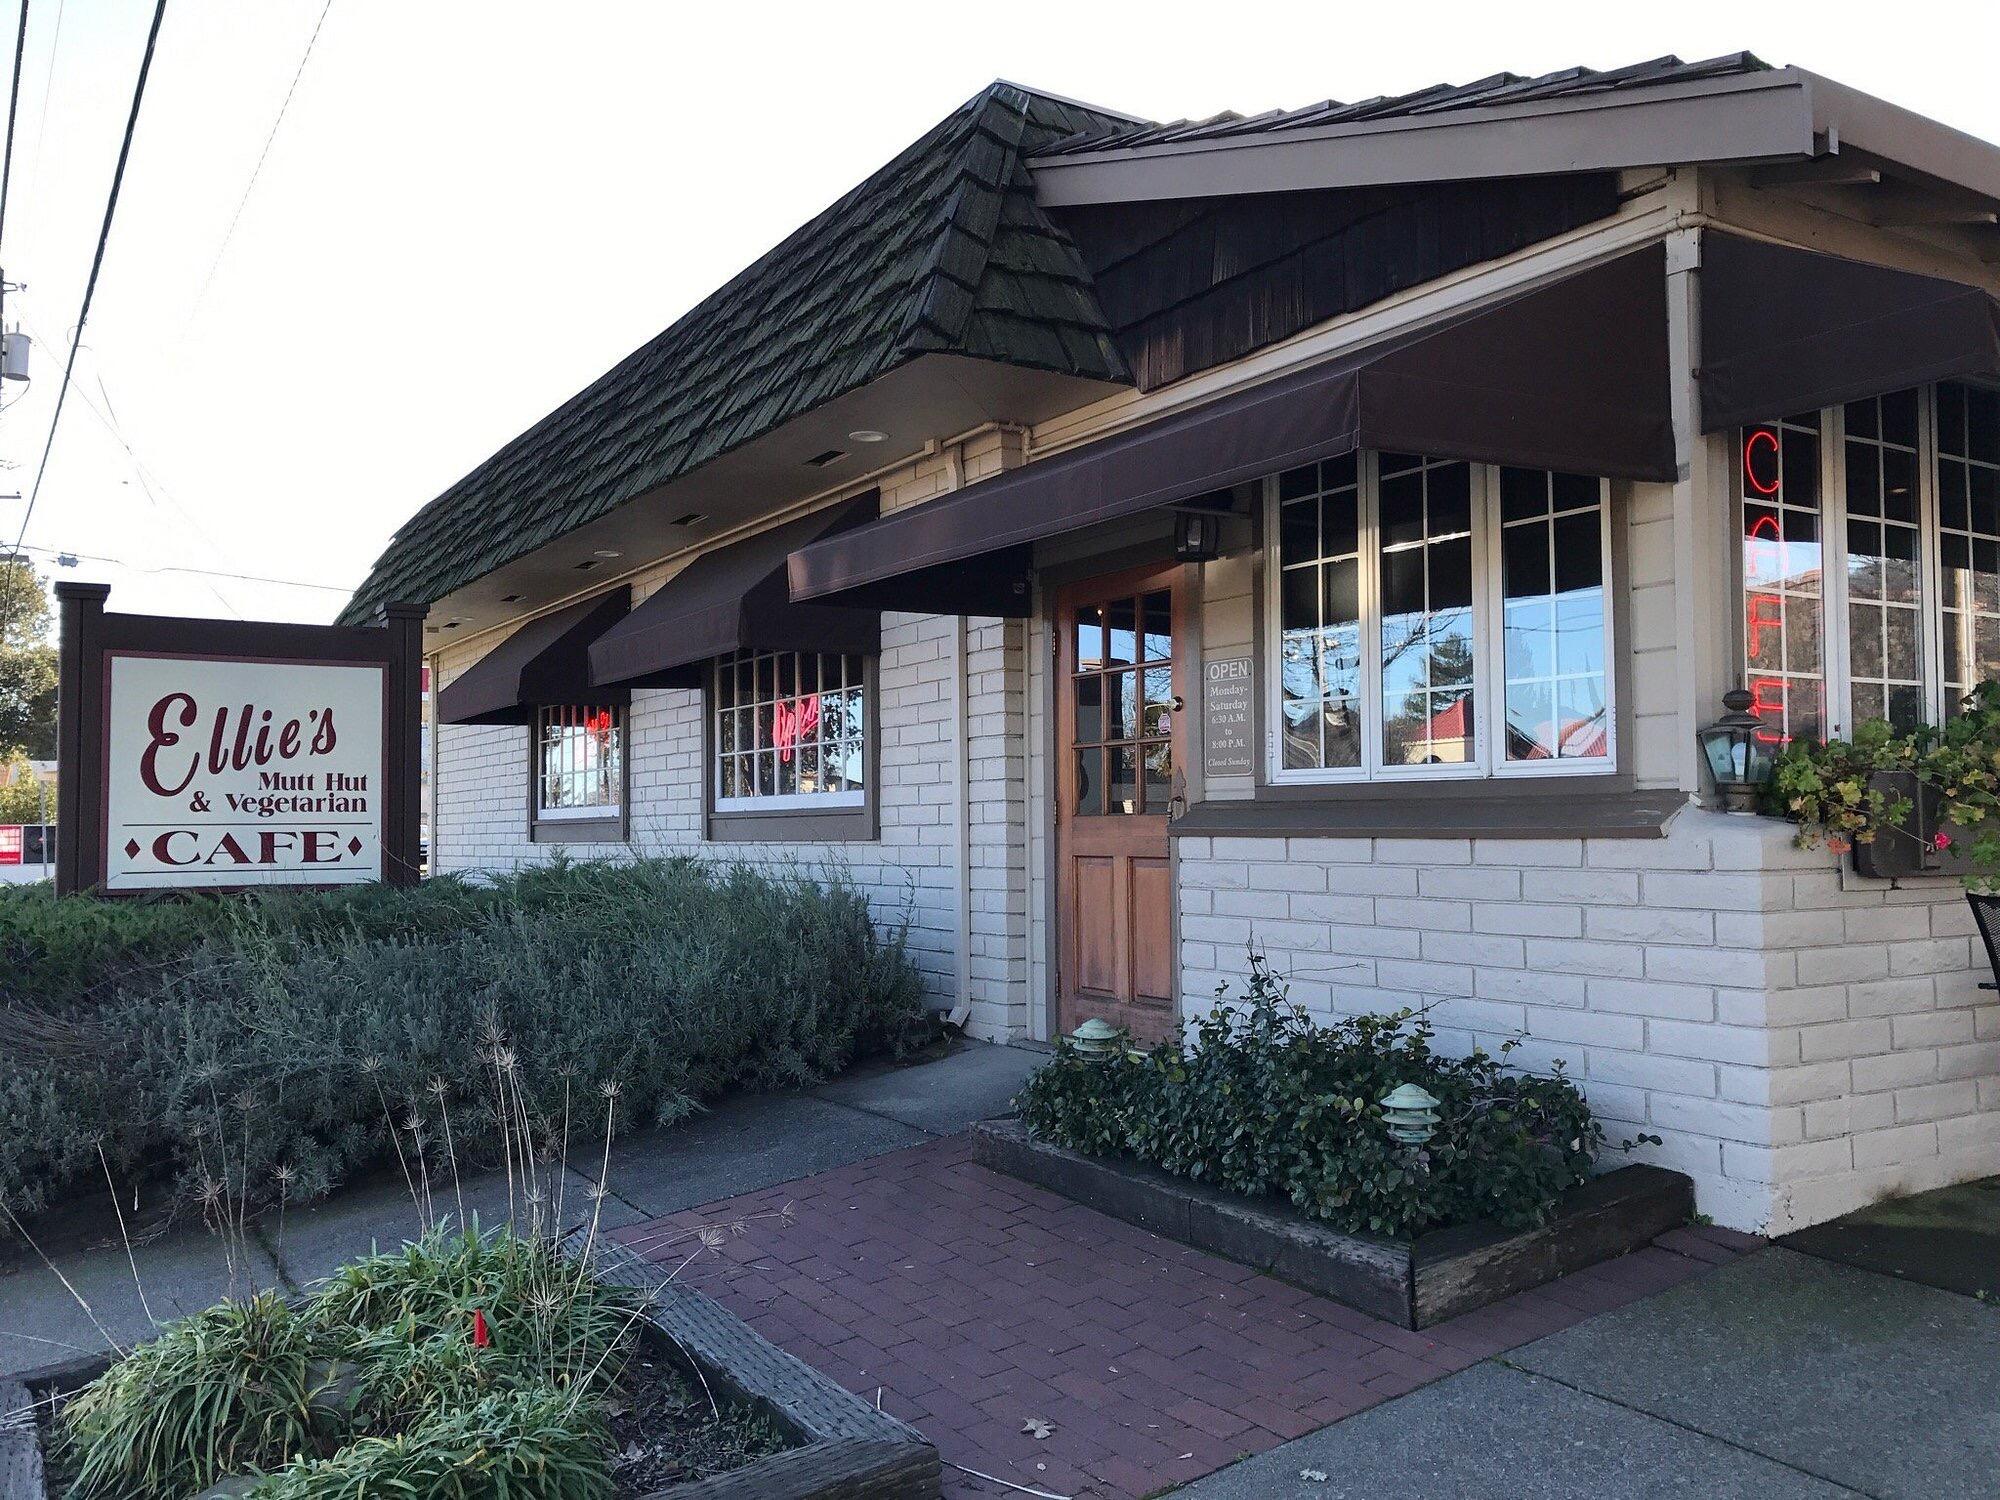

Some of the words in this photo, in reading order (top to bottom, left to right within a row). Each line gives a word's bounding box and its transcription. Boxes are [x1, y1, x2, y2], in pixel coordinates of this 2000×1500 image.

[1210, 661, 1248, 680] OPEN
[1210, 699, 1248, 711] Saturday
[1211, 714, 1227, 724] 6:30
[1228, 713, 1247, 723] A.M.
[1224, 728, 1233, 736] to
[140, 692, 337, 797] Ellie's
[1211, 739, 1227, 749] 8:00
[1228, 738, 1247, 748] P.M.
[1208, 758, 1227, 767] Closed
[1228, 757, 1251, 767] Sunday
[258, 771, 314, 791] Mutt
[325, 772, 368, 791] Hut
[189, 791, 211, 813] &
[225, 793, 368, 817] Vegetarian
[152, 830, 343, 866] CAFE
